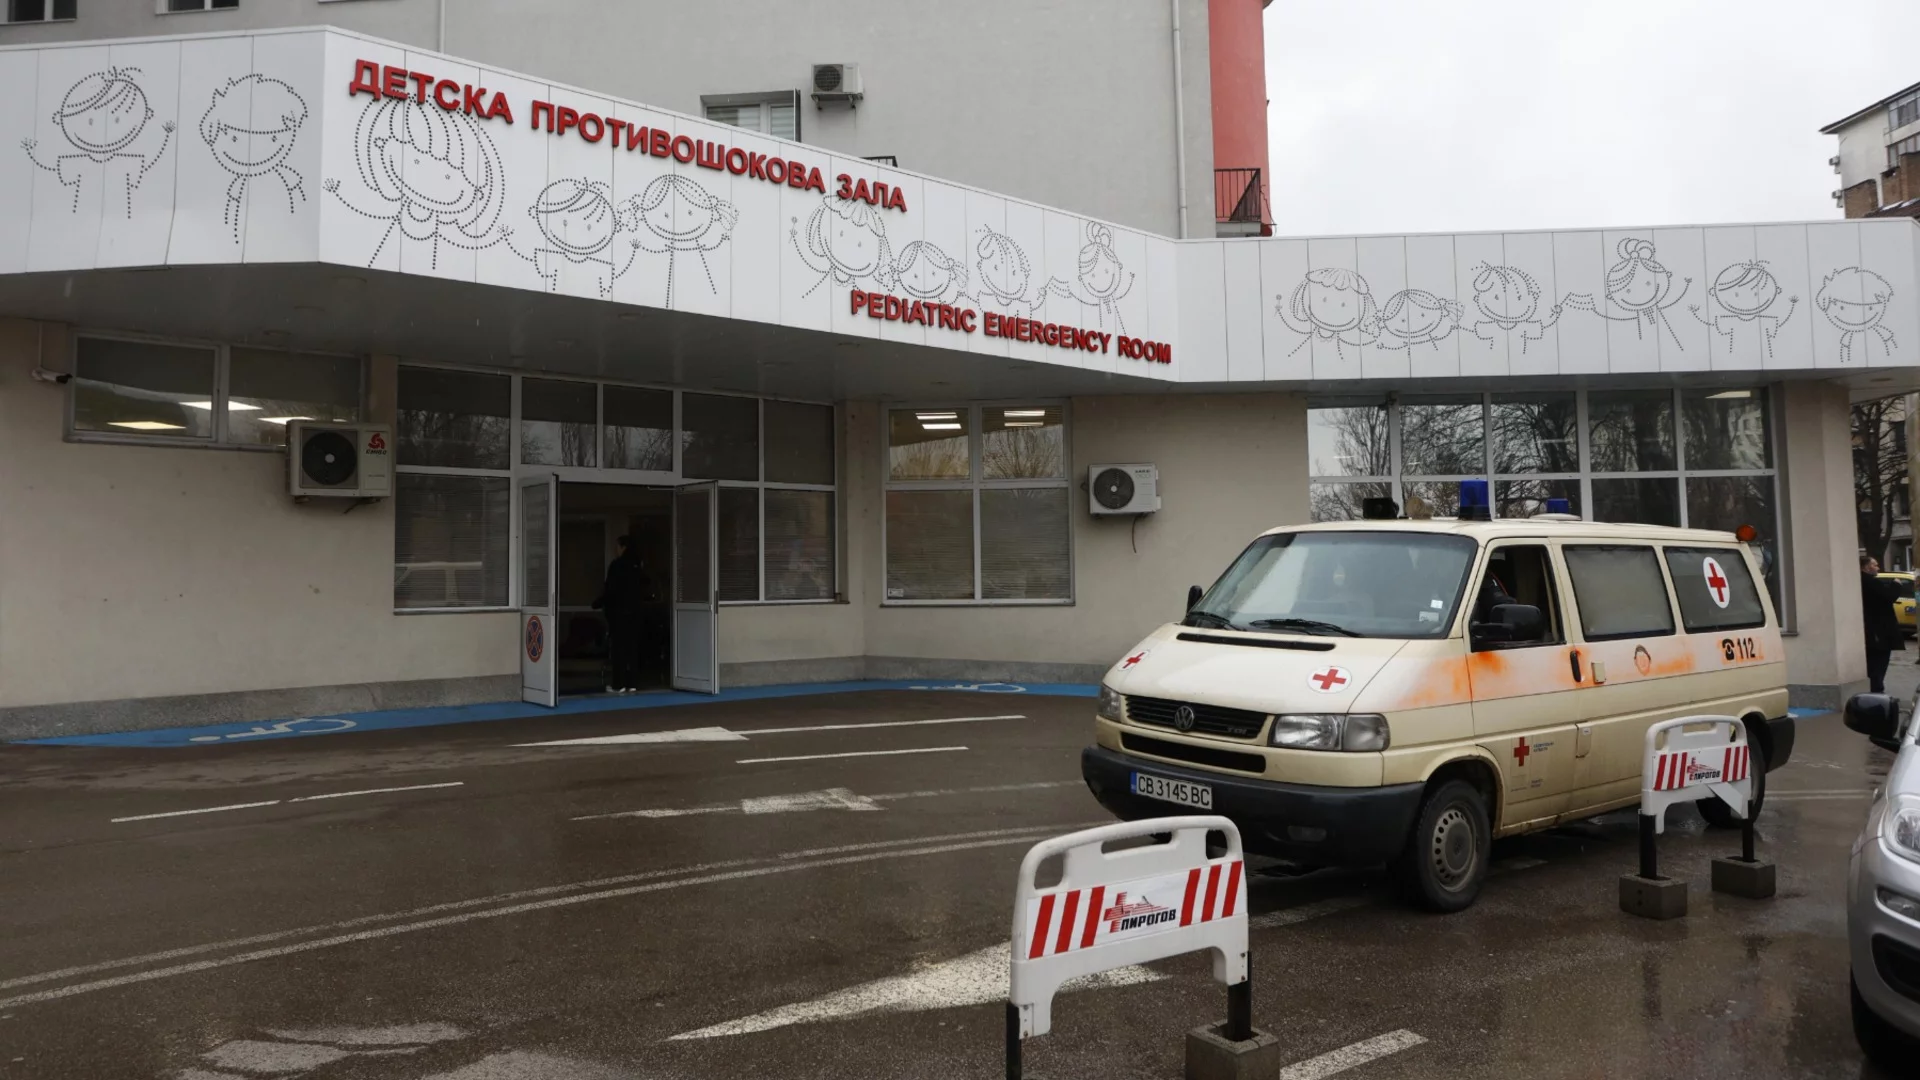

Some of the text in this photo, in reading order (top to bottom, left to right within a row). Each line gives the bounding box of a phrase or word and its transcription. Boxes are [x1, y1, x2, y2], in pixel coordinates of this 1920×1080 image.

[349, 58, 908, 213] ДЕТСКА ПРОТИВОШОКОВА ЗАЛА
[850, 289, 1172, 364] PEDIATRIC EMERGENCY ROOM
[1737, 637, 1756, 659] 112
[1138, 776, 1210, 806] CB 3145 BC
[1121, 909, 1177, 931] ПИРОГОВ
